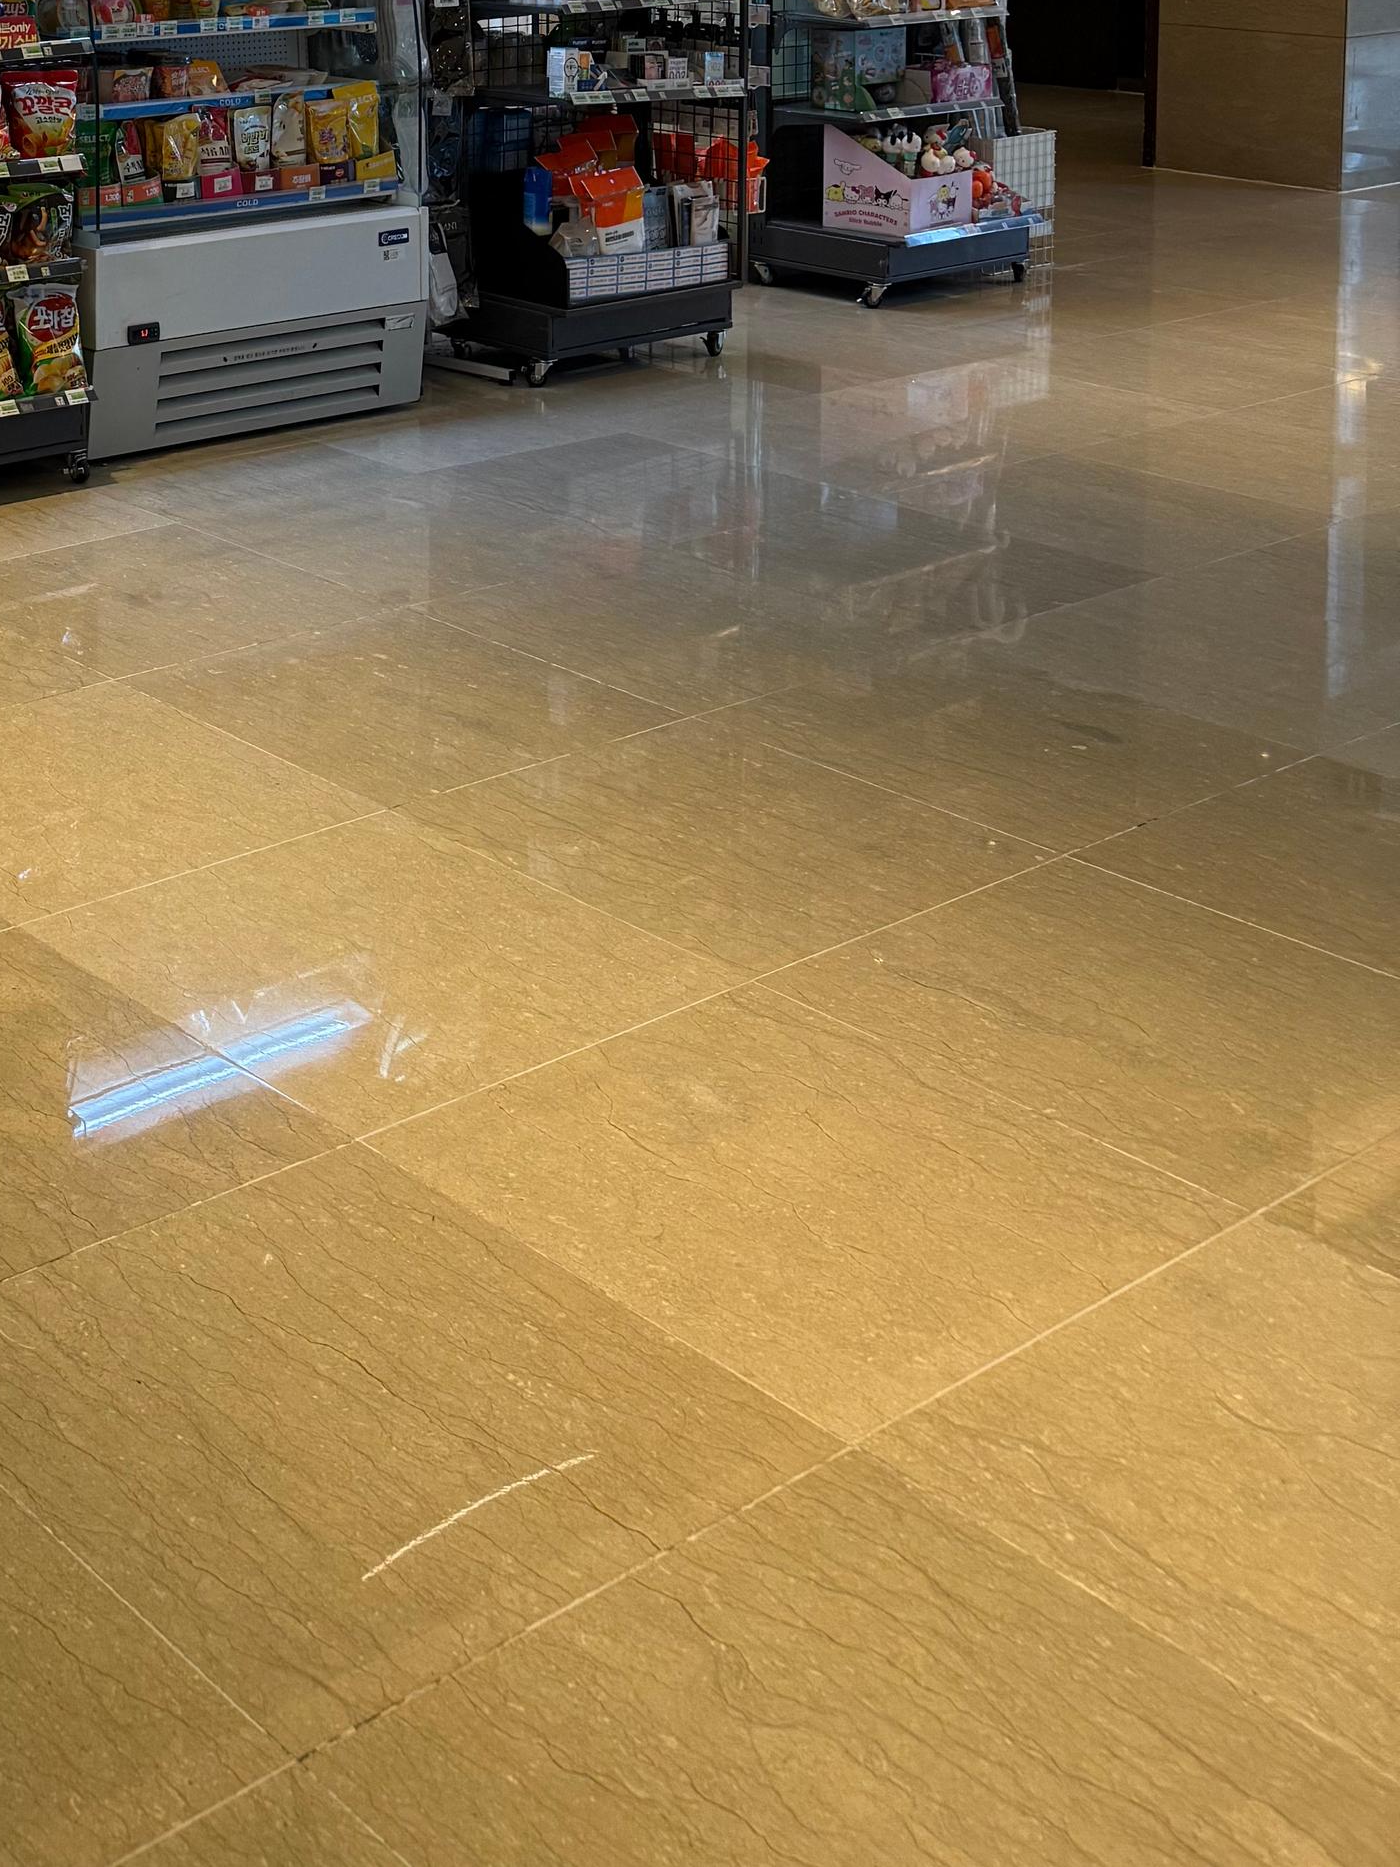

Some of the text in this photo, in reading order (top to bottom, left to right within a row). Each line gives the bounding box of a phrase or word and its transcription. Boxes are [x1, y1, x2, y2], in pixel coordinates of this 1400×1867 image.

[15, 95, 73, 117] 꼬깔콘
[219, 97, 242, 107] COLD
[236, 198, 260, 208] COLD
[29, 305, 76, 331] 포카칩
